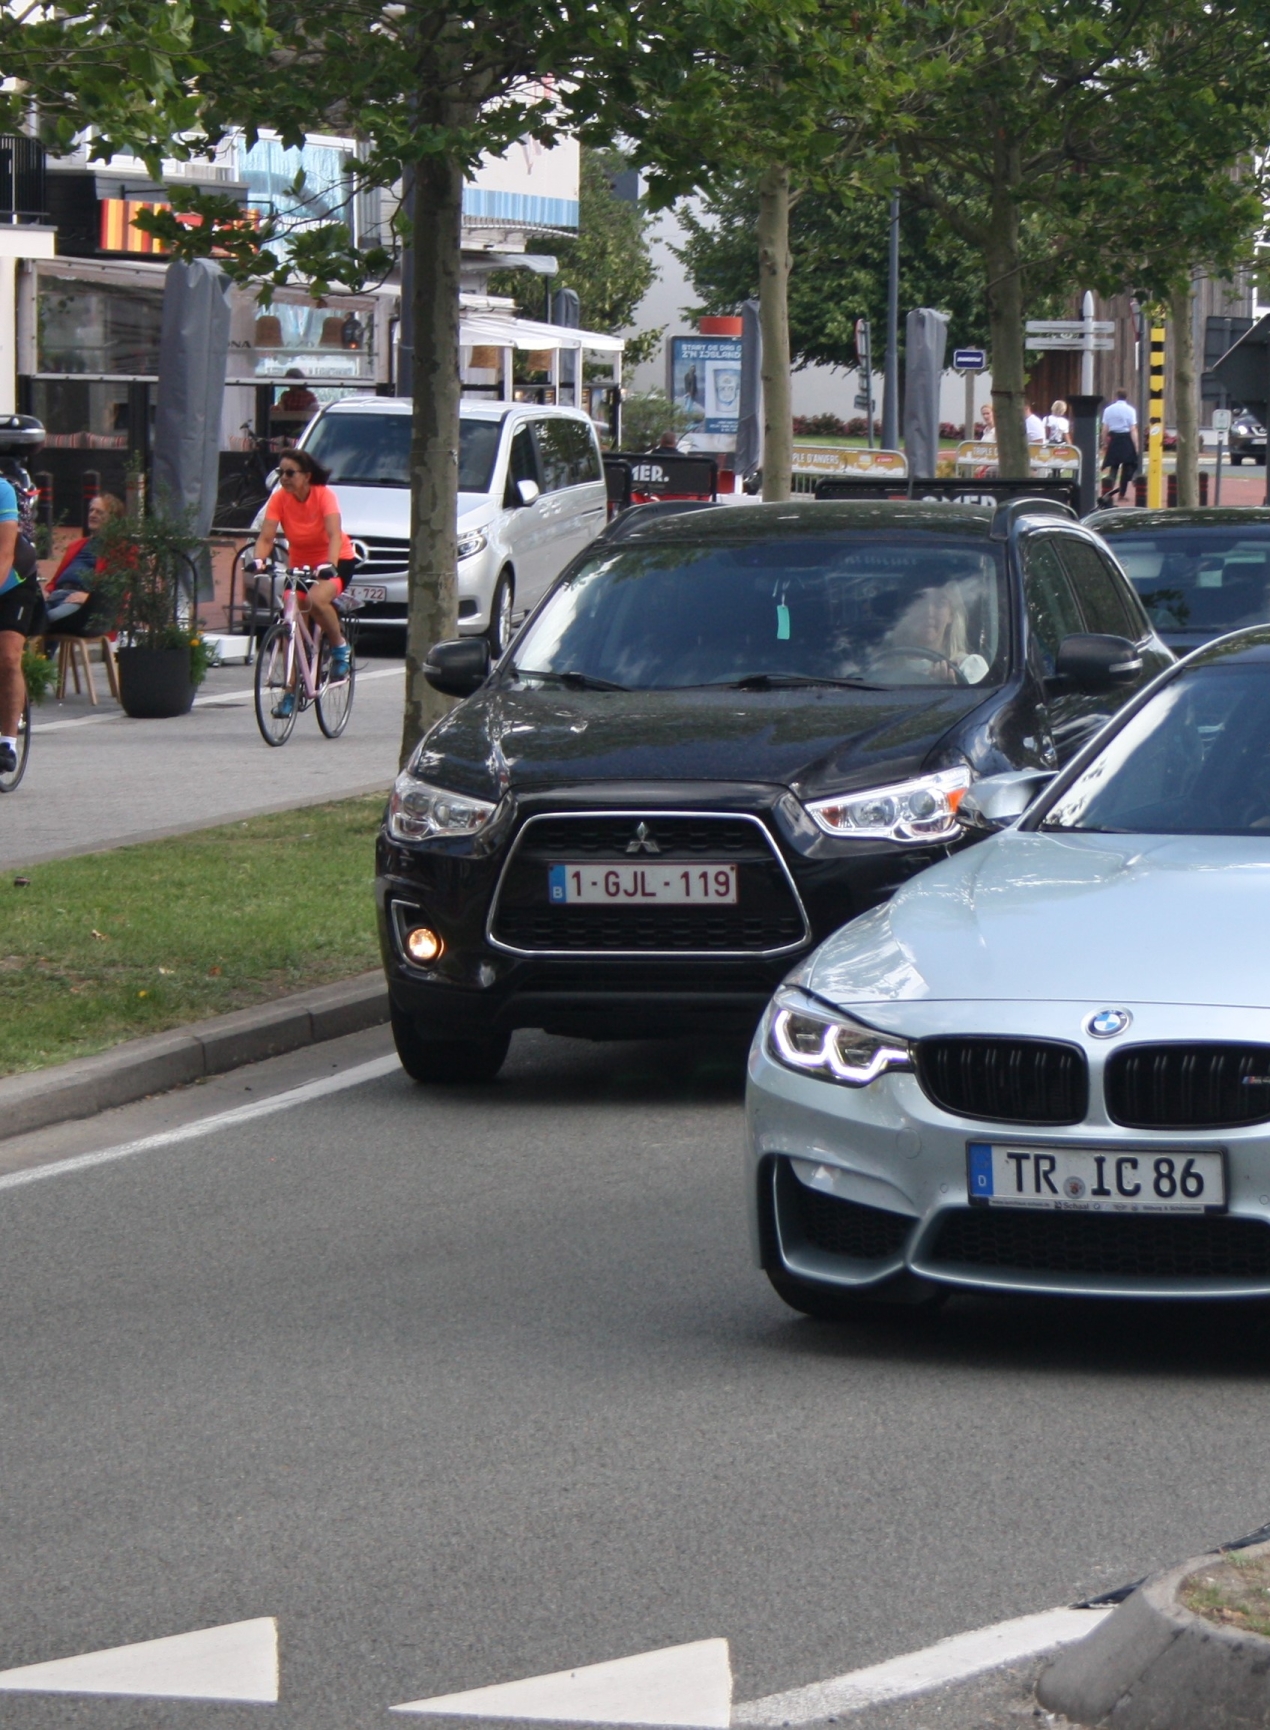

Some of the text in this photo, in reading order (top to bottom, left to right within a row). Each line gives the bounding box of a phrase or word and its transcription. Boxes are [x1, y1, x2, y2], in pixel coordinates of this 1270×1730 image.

[228, 340, 251, 348] NA
[1006, 1151, 1059, 1194] TR
[1091, 1155, 1142, 1197] IC
[1152, 1156, 1205, 1198] 86
[1063, 1201, 1089, 1211] Schaal
